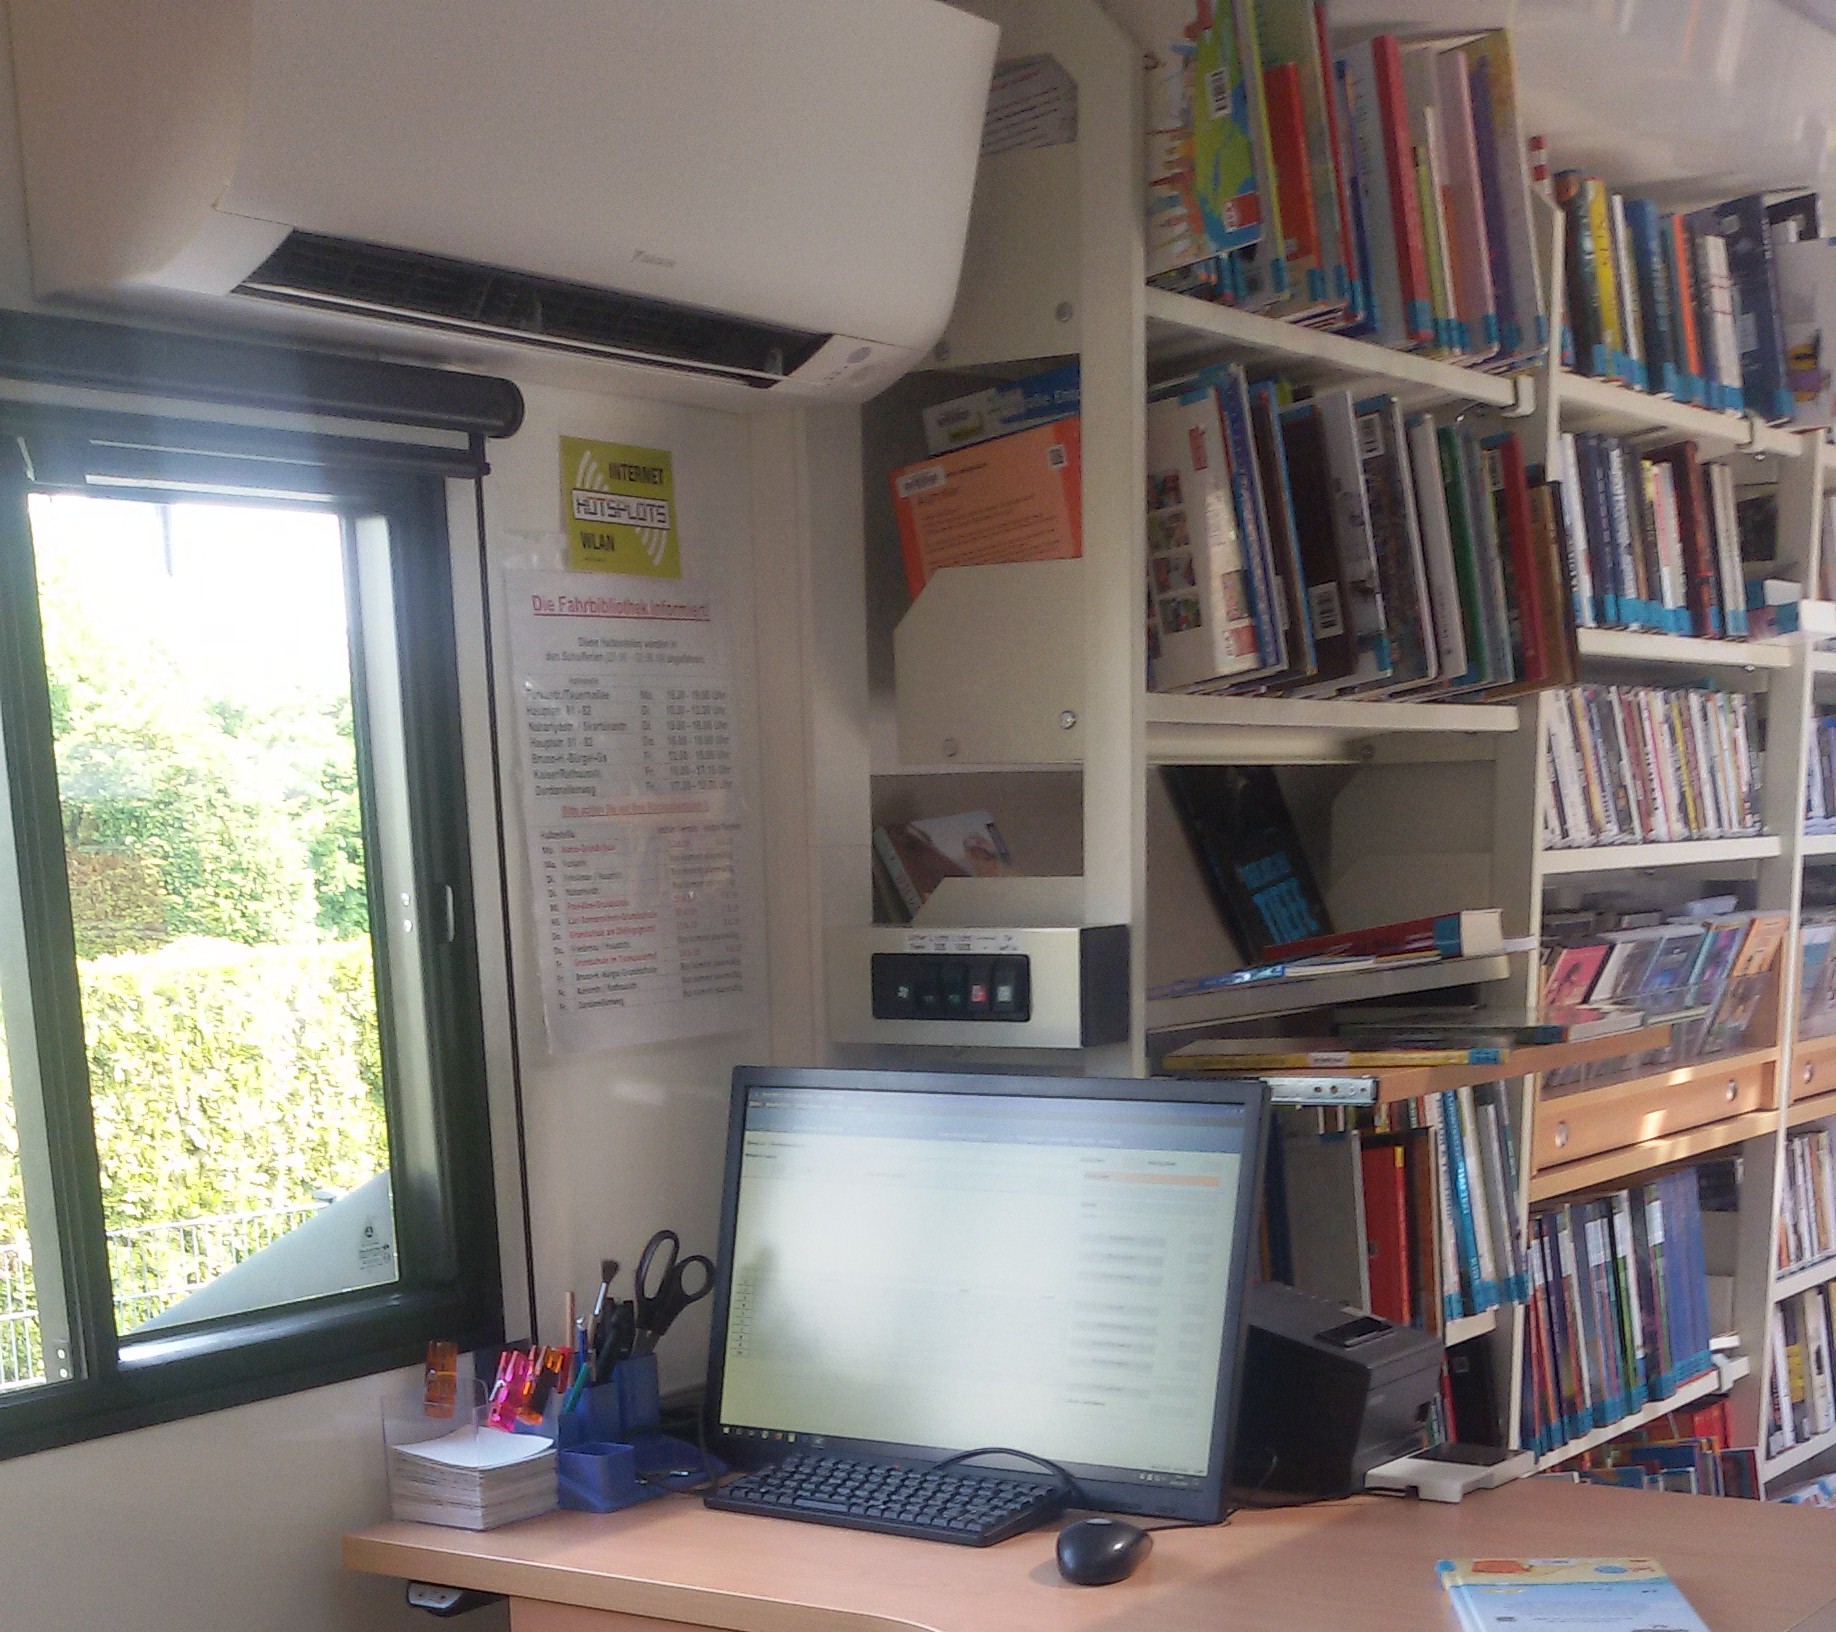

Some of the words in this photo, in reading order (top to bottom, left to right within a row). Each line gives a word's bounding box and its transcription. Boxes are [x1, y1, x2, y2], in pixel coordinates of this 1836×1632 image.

[609, 462, 663, 485] INTERNET
[580, 531, 615, 551] WLAN
[532, 594, 555, 612] Die
